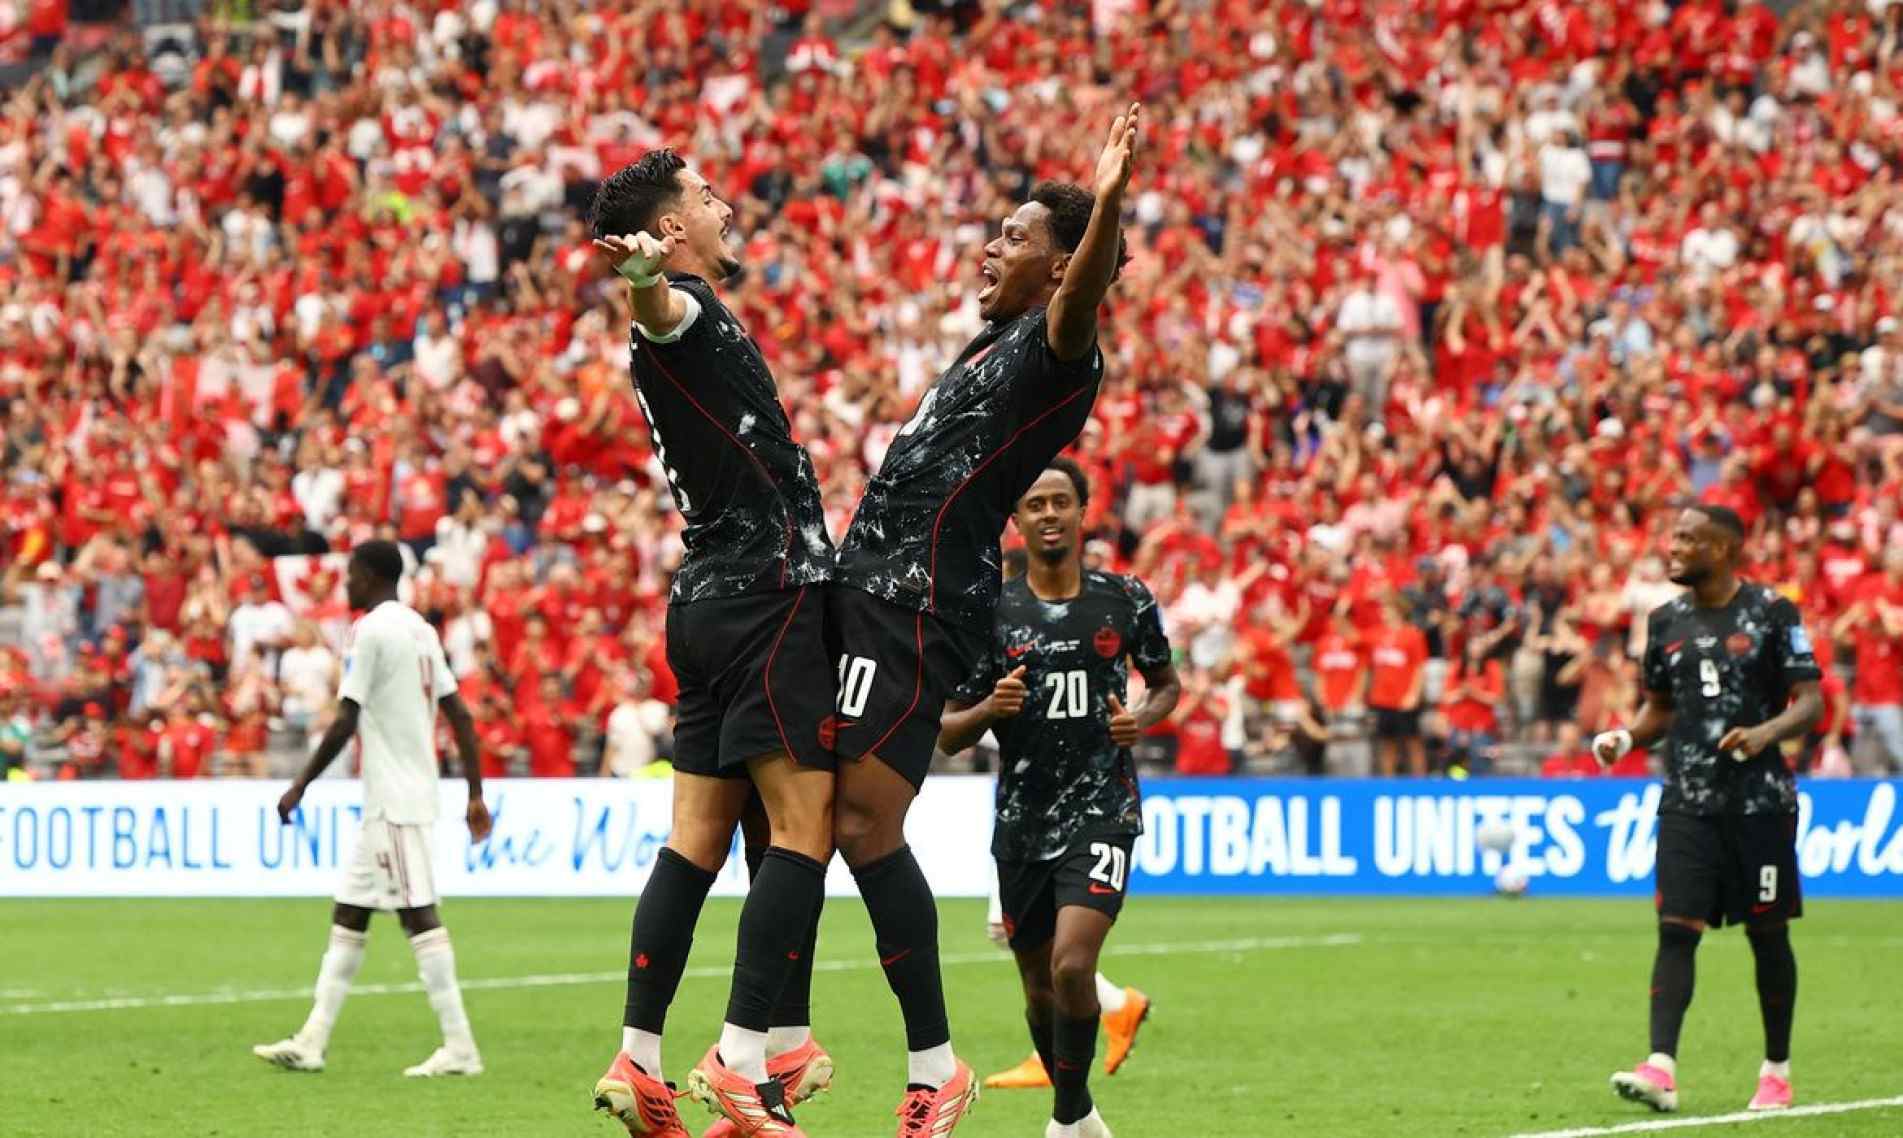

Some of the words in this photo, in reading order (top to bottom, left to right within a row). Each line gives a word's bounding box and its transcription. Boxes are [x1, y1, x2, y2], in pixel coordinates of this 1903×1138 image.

[1046, 669, 1089, 719] 20
[1699, 658, 1721, 697] 9
[0, 806, 232, 869] OOTBALL
[1130, 795, 1358, 876] OTBALL
[1374, 795, 1586, 877] UNITES
[1088, 842, 1126, 893] 20
[1759, 865, 1778, 903] 9
